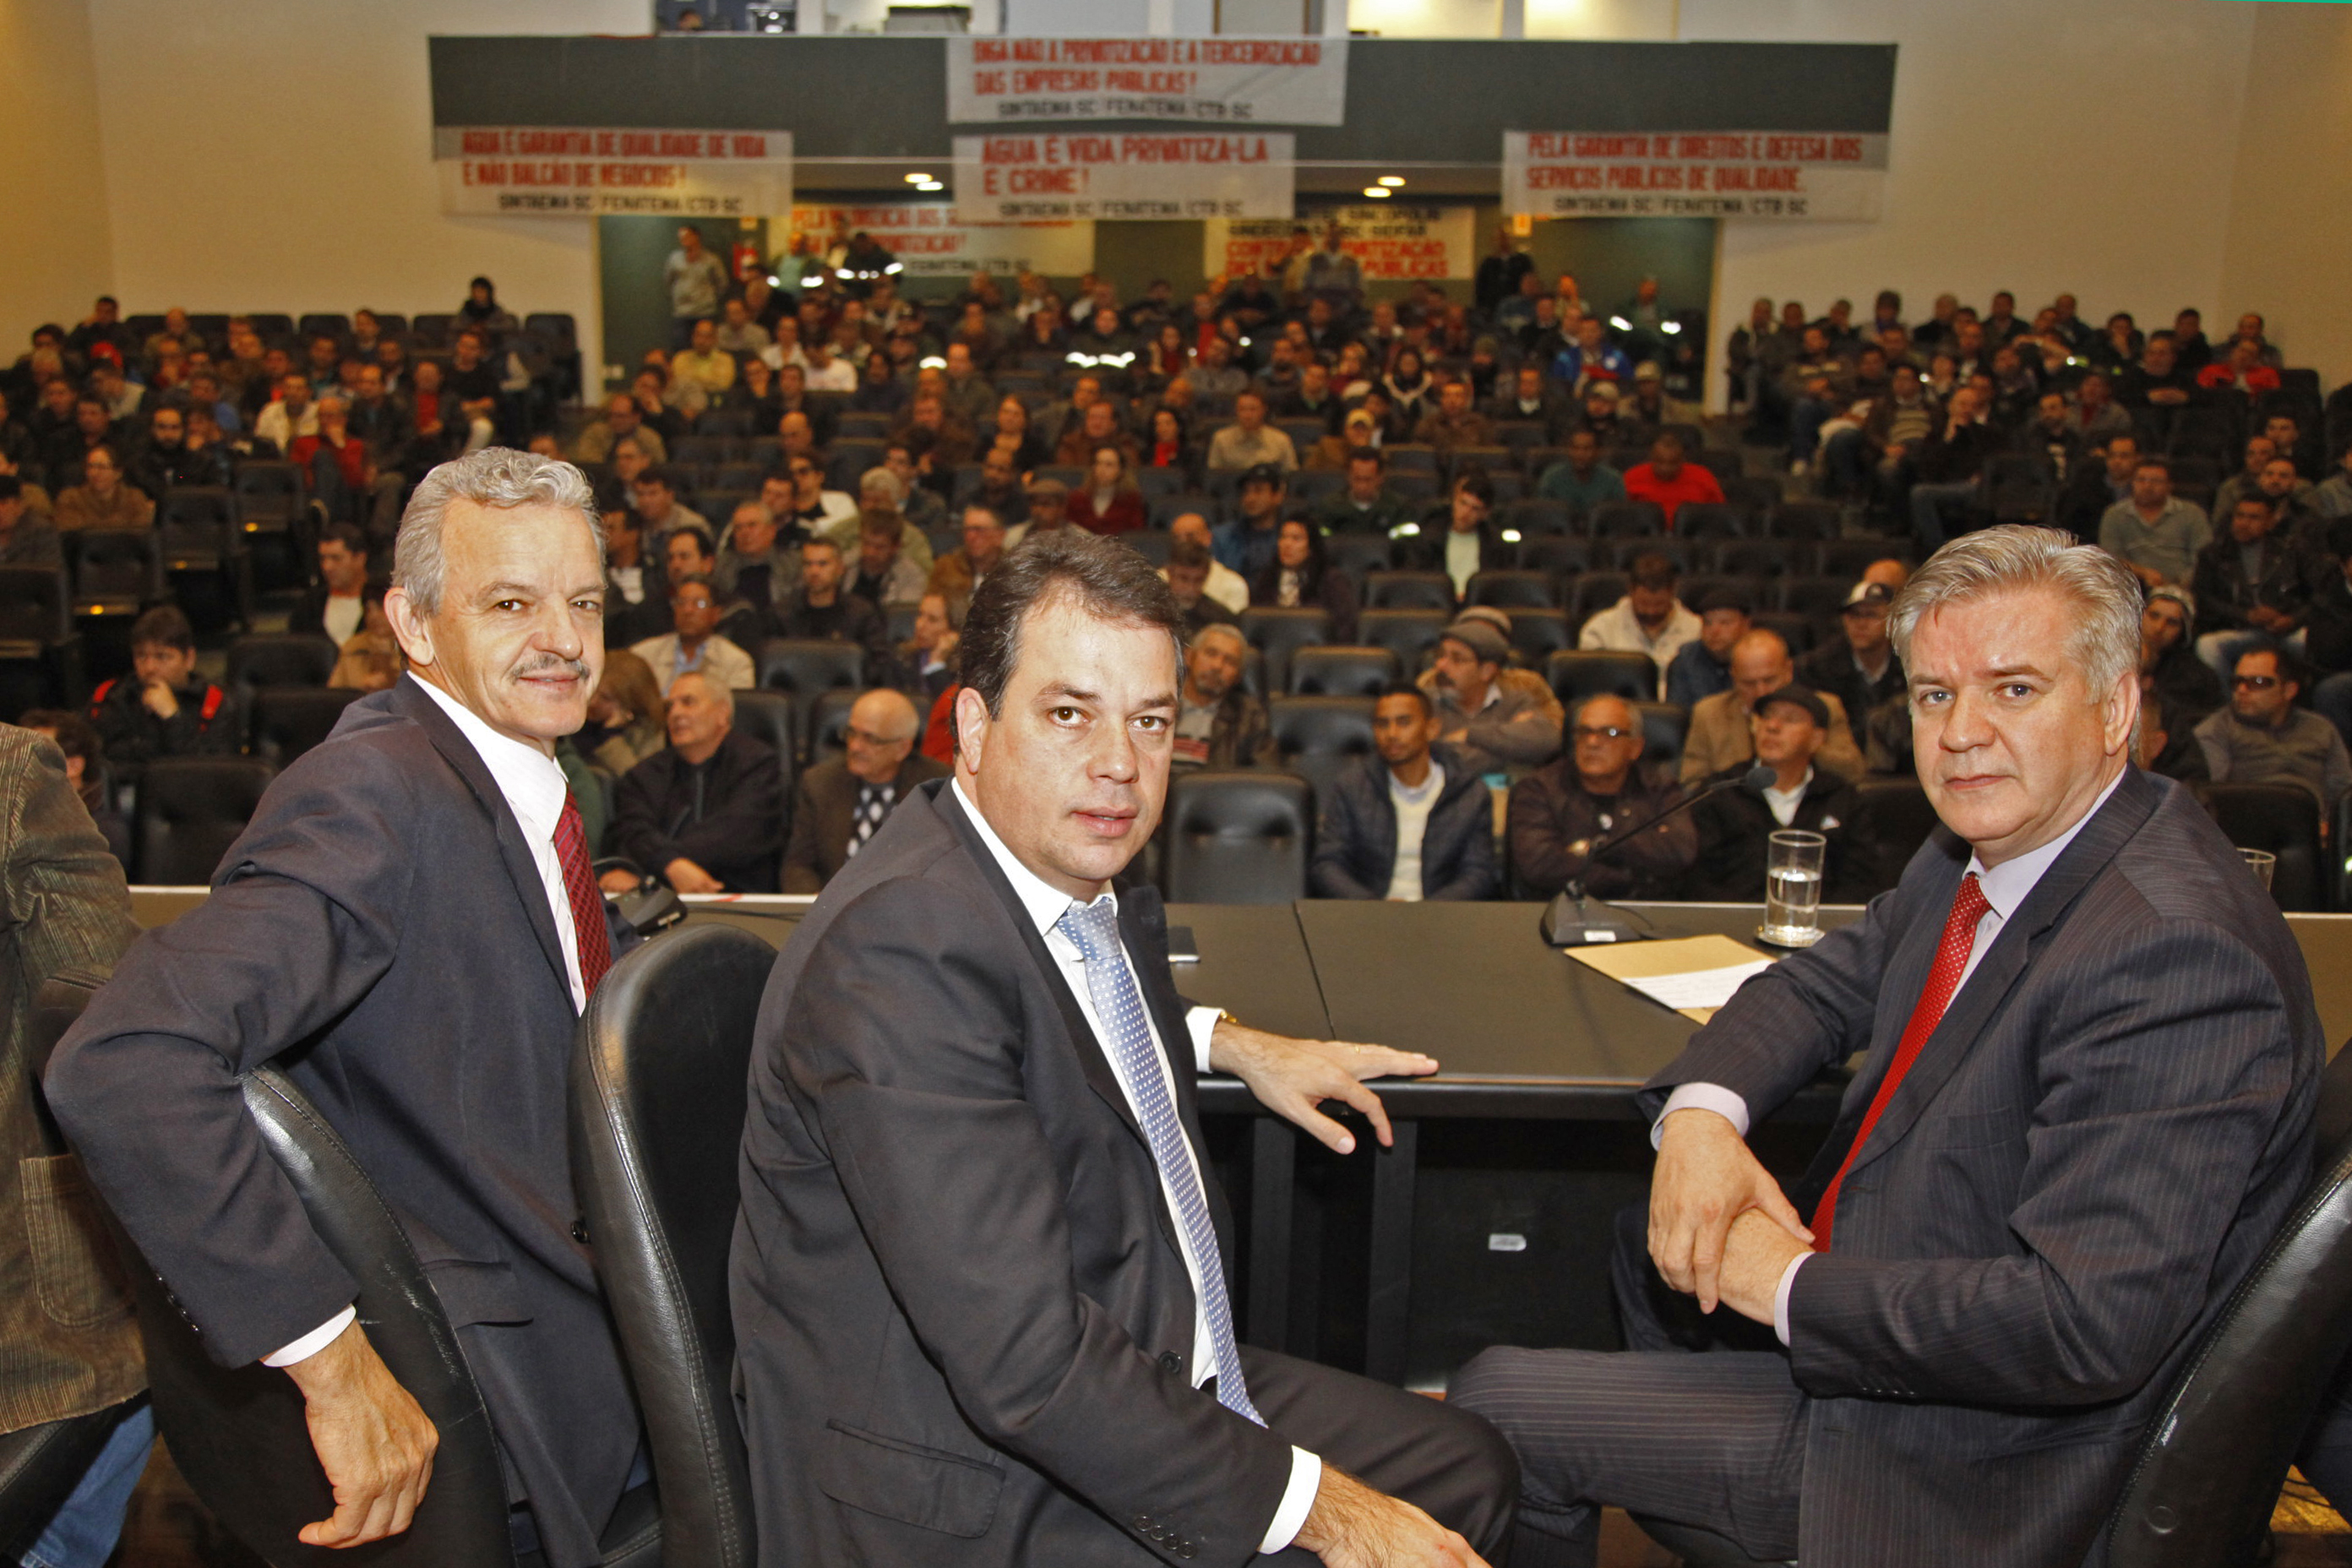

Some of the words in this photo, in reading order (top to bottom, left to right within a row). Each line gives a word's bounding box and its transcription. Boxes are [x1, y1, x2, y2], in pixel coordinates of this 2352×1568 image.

[973, 71, 1007, 95] DAS
[1013, 69, 1098, 95] EMPRESAS
[621, 133, 702, 158] QUALIDADE
[732, 135, 765, 158] VIDA
[1066, 138, 1115, 163] VIDA
[1528, 133, 1569, 158] PELA
[1767, 137, 1826, 161] DEFESA
